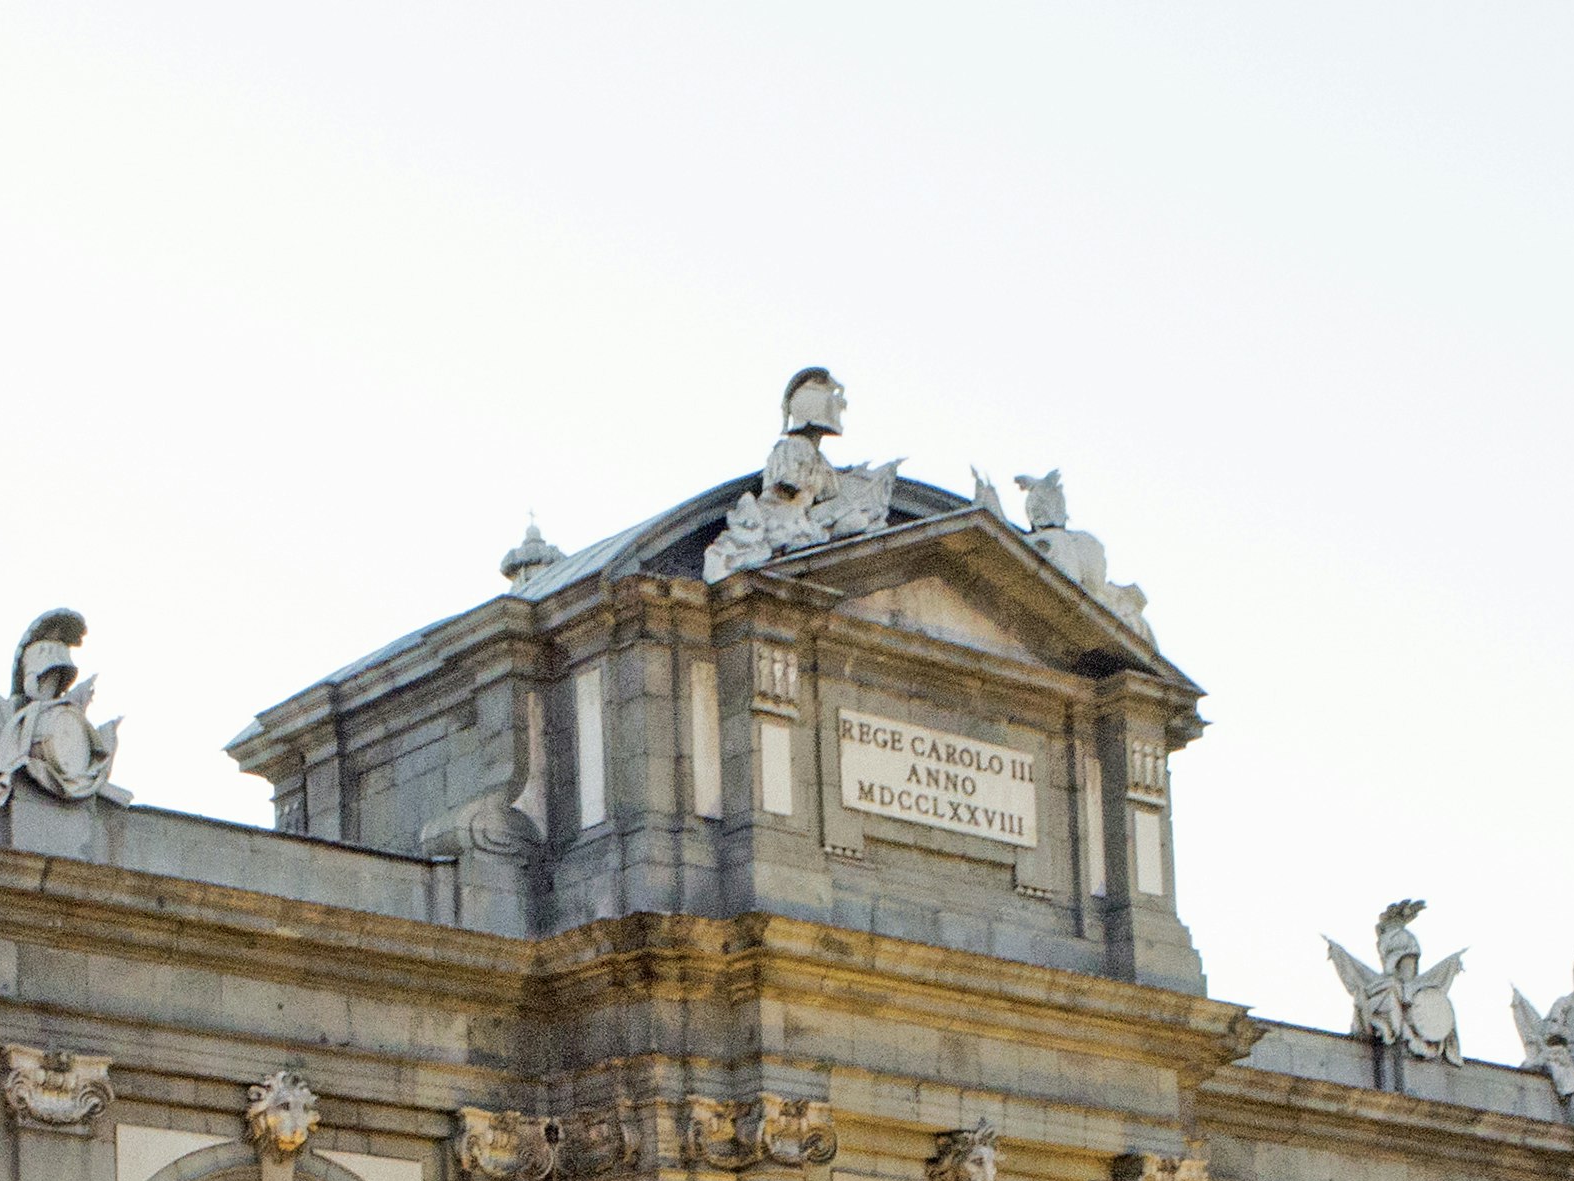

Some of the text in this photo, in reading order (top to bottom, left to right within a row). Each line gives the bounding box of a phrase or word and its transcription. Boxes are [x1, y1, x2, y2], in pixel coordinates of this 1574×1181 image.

[841, 719, 1033, 782] REGE CAROLO III
[907, 764, 975, 795] ANNO
[858, 780, 1024, 835] MDCCLXXVIII
